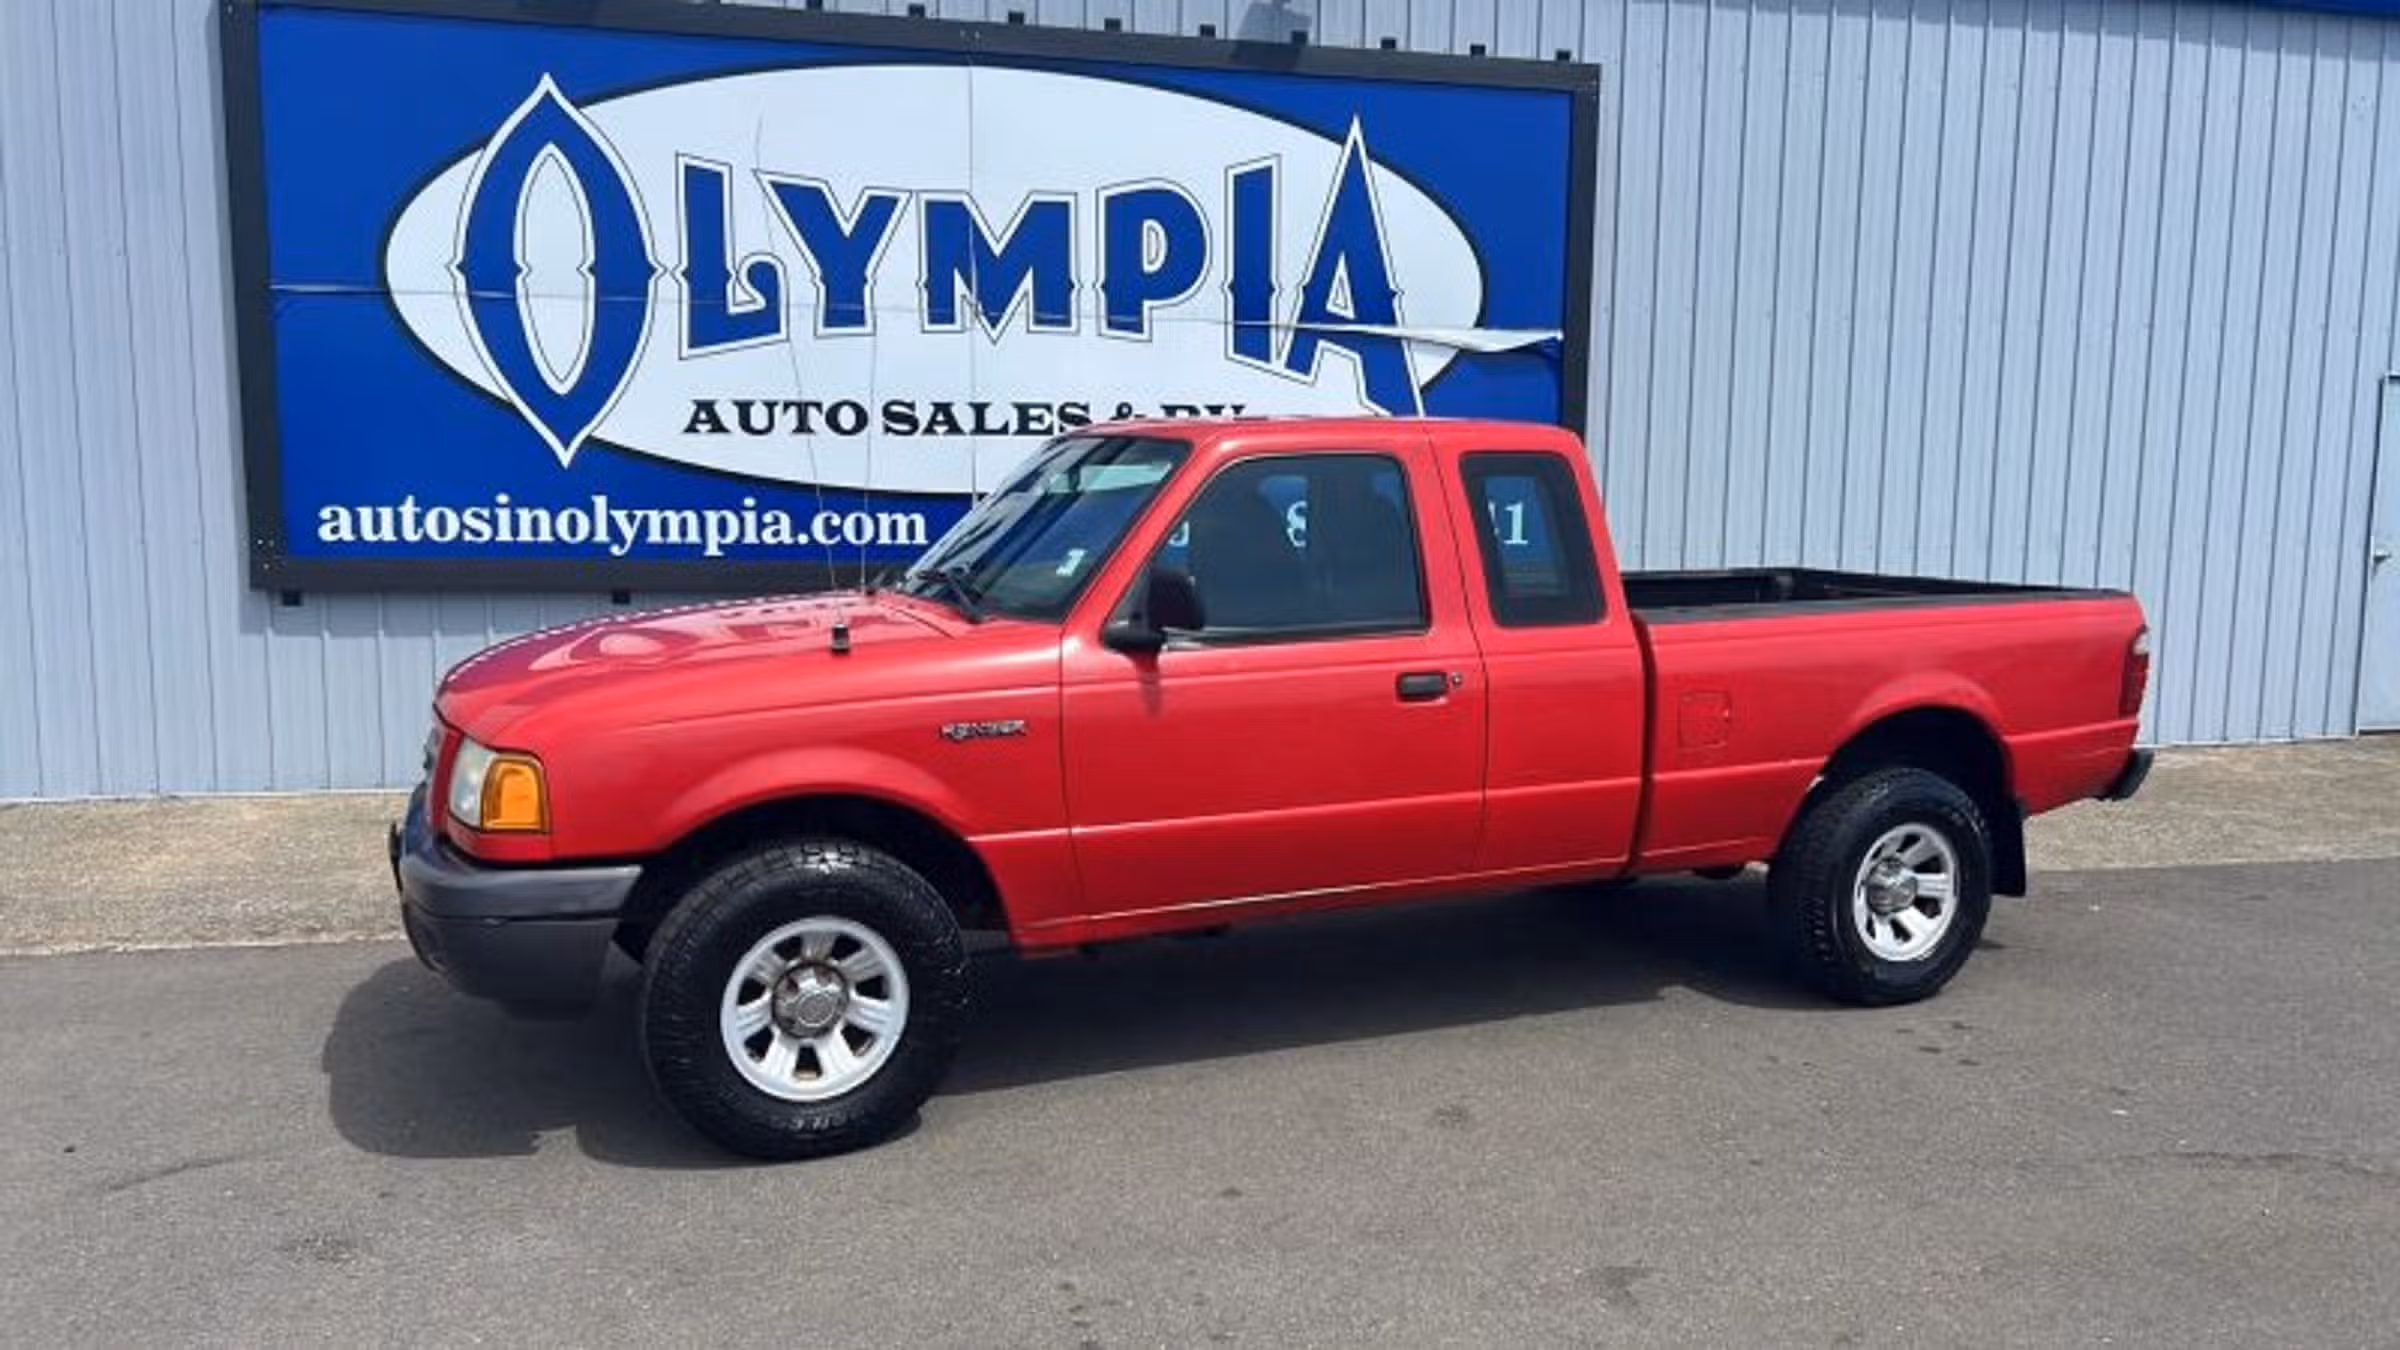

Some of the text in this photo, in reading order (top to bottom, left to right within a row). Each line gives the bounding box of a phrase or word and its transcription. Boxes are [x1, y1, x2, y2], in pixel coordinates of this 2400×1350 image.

[446, 72, 1424, 467] OLYMPIA
[684, 399, 869, 436] AUTO
[881, 400, 1092, 437] SALES
[317, 493, 929, 556] autosinolympia.com
